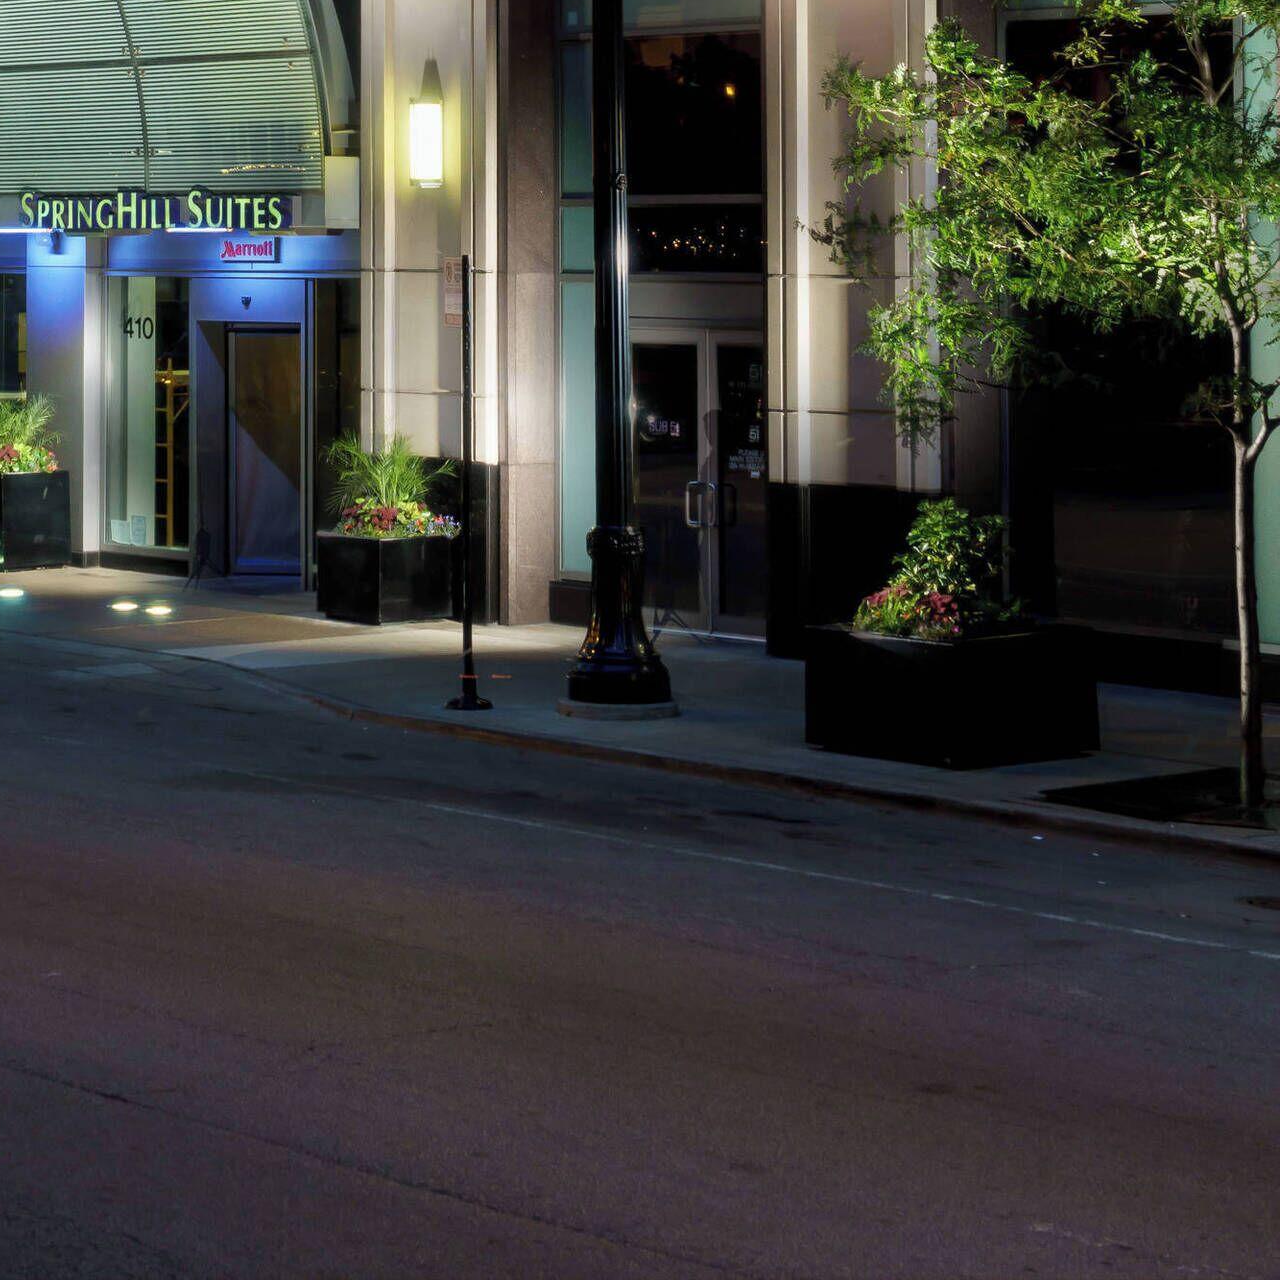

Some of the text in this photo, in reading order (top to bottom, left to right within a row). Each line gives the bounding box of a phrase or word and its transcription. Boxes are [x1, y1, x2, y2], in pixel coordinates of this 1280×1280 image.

[187, 191, 284, 230] SUITES
[221, 240, 272, 259] Marriott
[123, 317, 154, 340] 410
